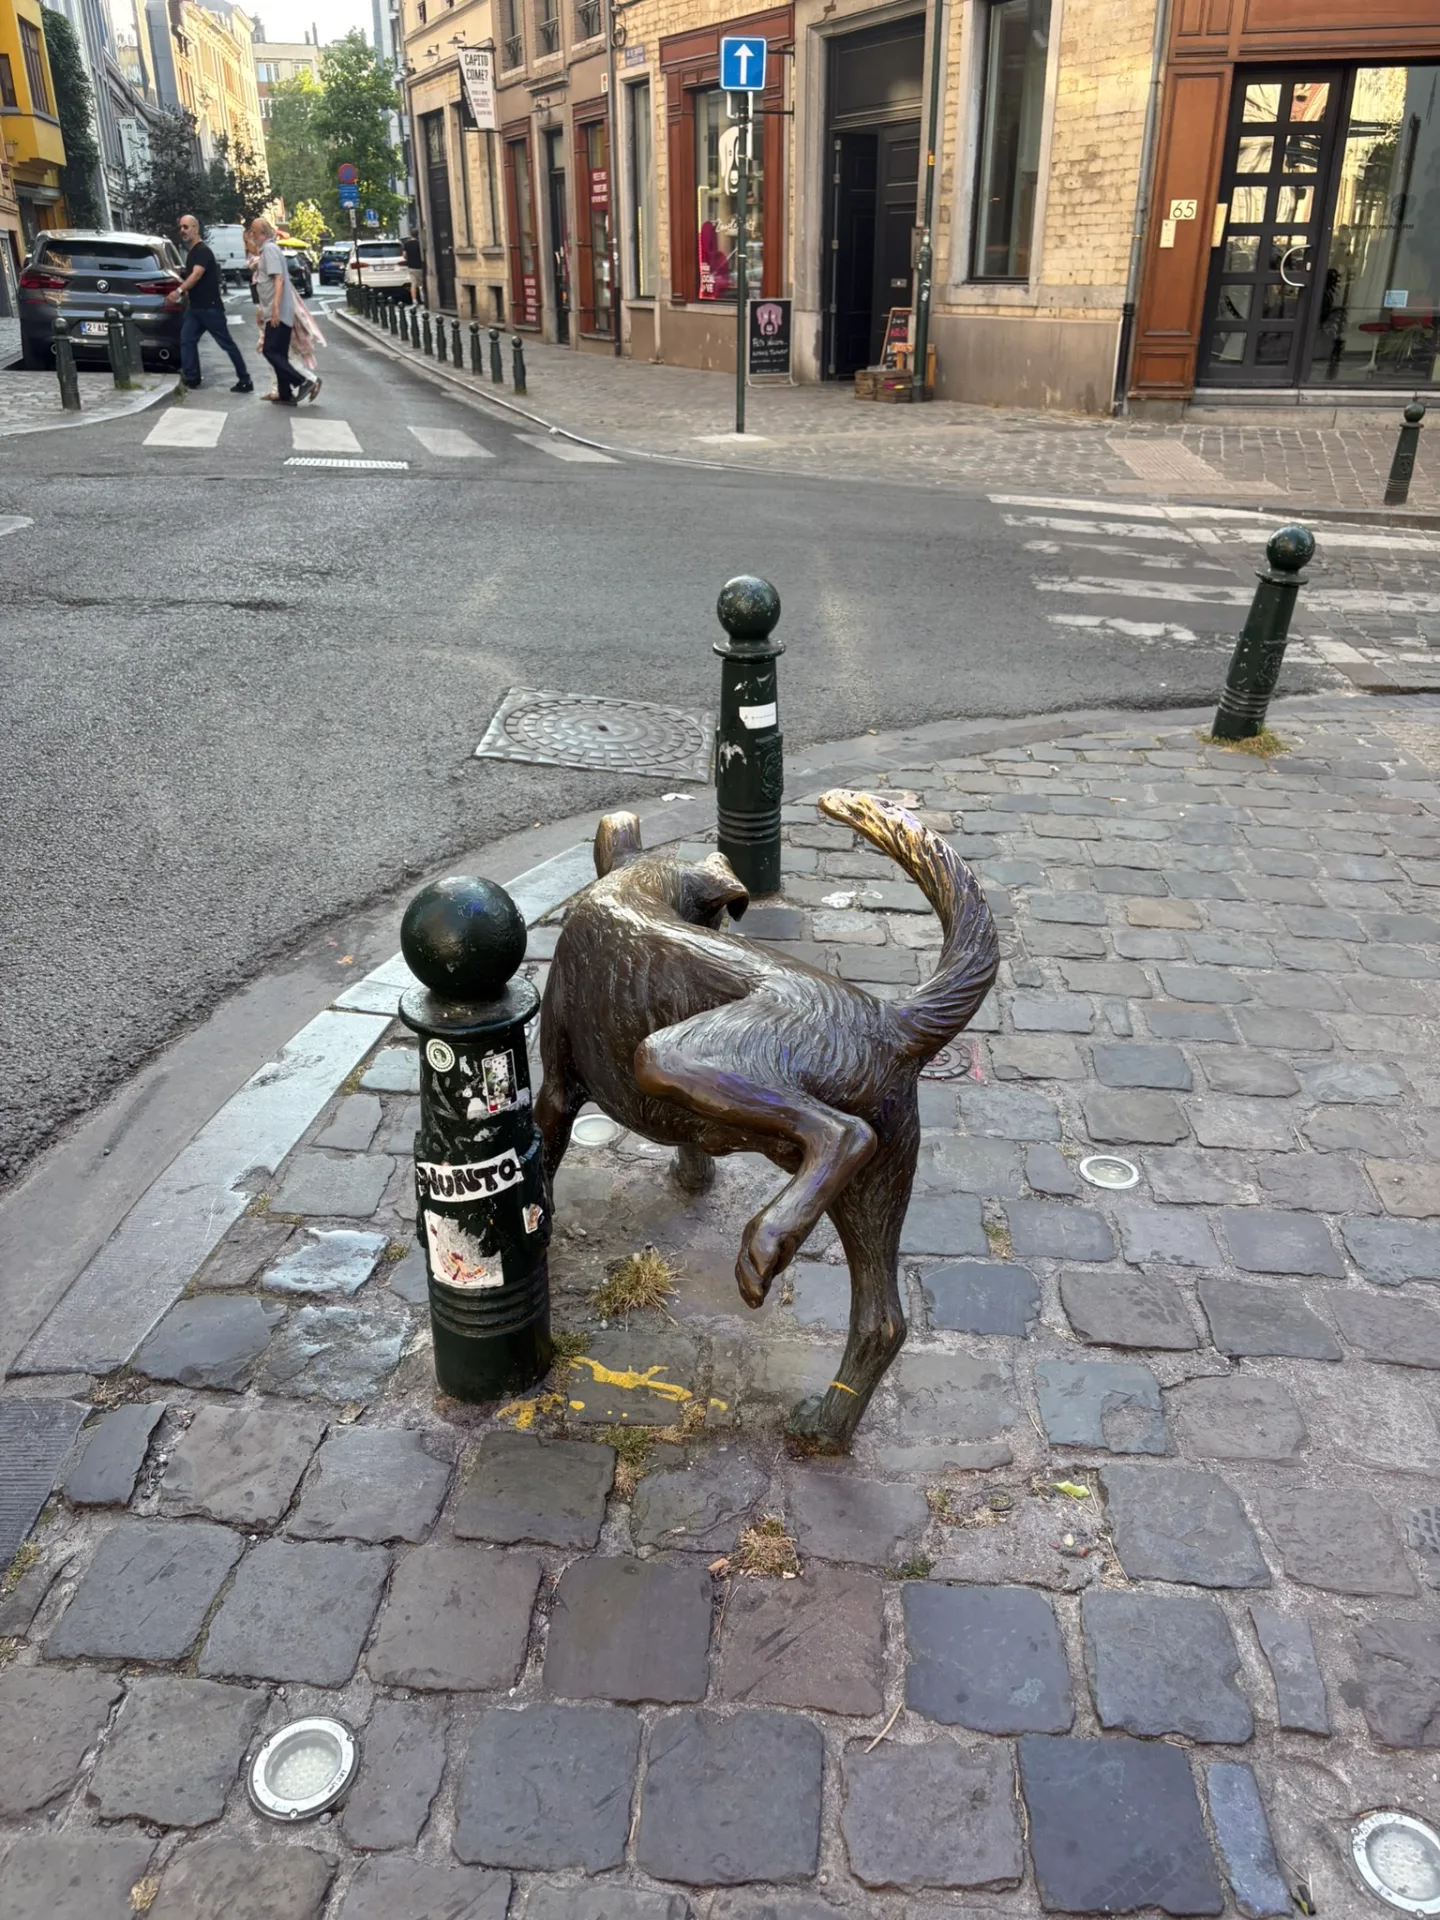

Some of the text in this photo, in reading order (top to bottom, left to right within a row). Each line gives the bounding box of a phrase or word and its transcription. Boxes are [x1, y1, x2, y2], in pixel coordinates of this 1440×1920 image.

[464, 53, 489, 67] CAPITO
[466, 68, 489, 81] COME?
[1172, 201, 1195, 218] 65
